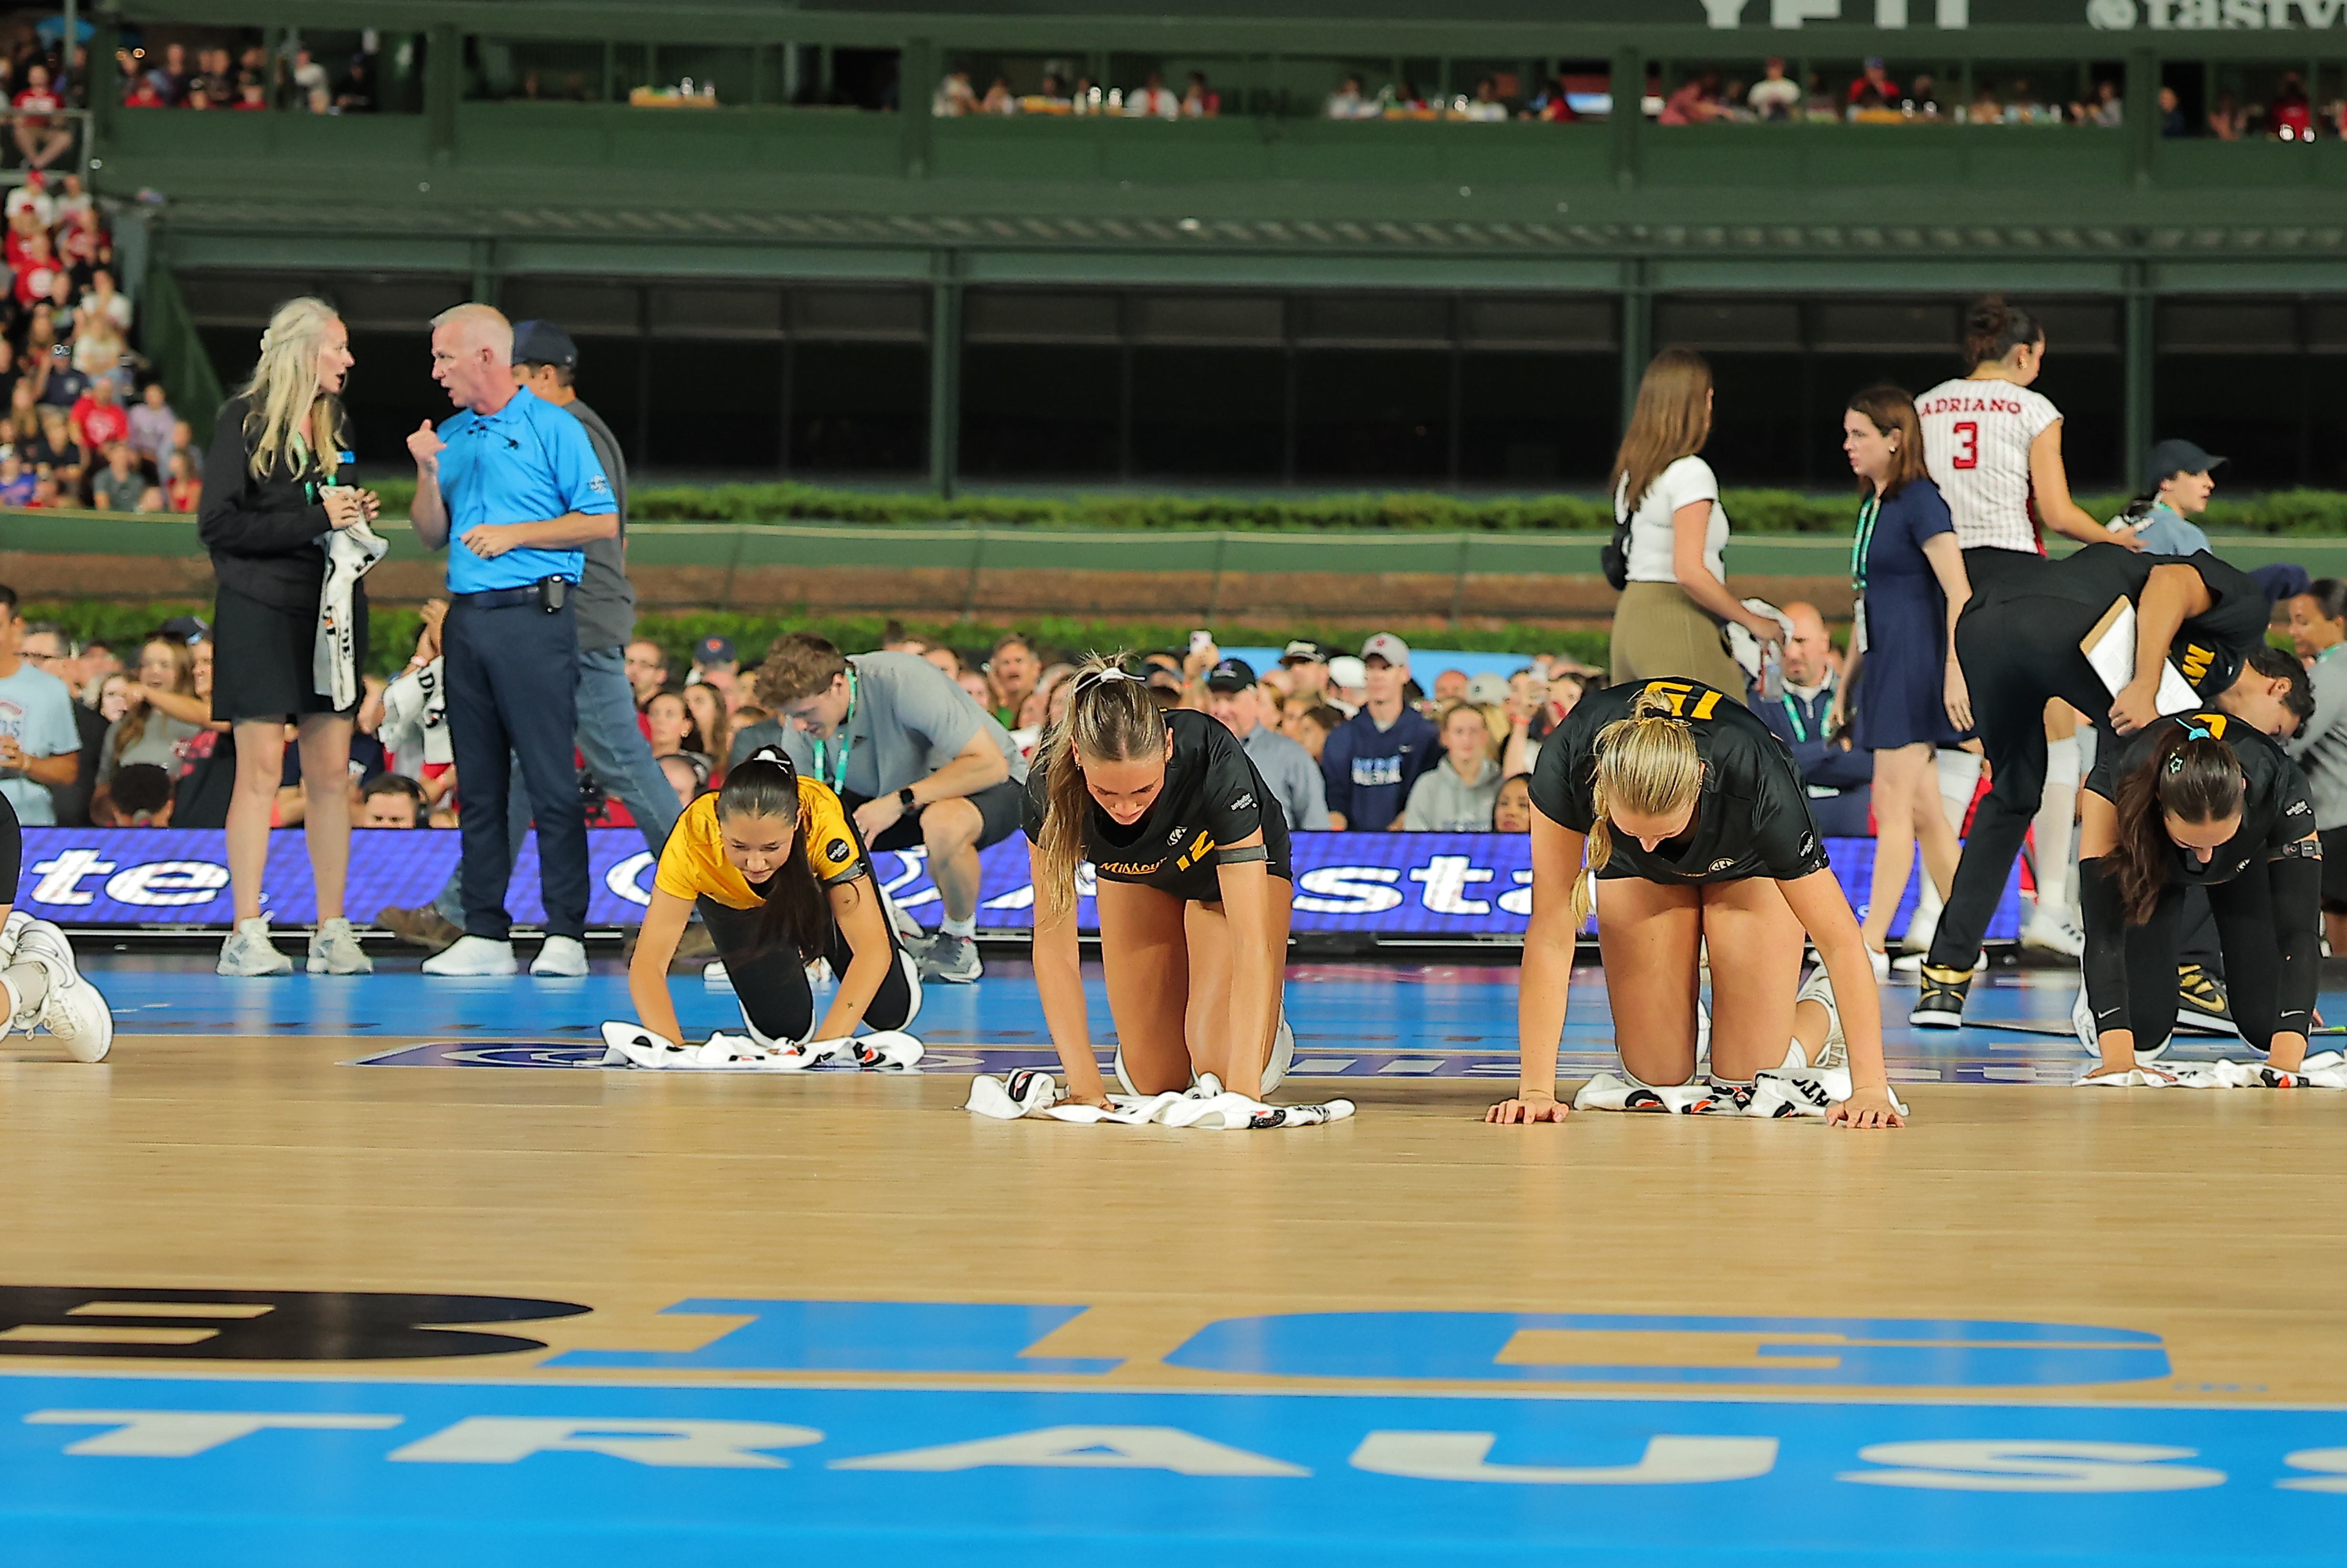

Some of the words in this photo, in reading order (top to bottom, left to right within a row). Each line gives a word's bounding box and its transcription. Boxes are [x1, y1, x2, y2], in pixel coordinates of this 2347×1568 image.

[1921, 398, 2021, 416] ADRIANO
[1953, 421, 1977, 469] 3
[23, 1409, 2347, 1493] TRAUS
